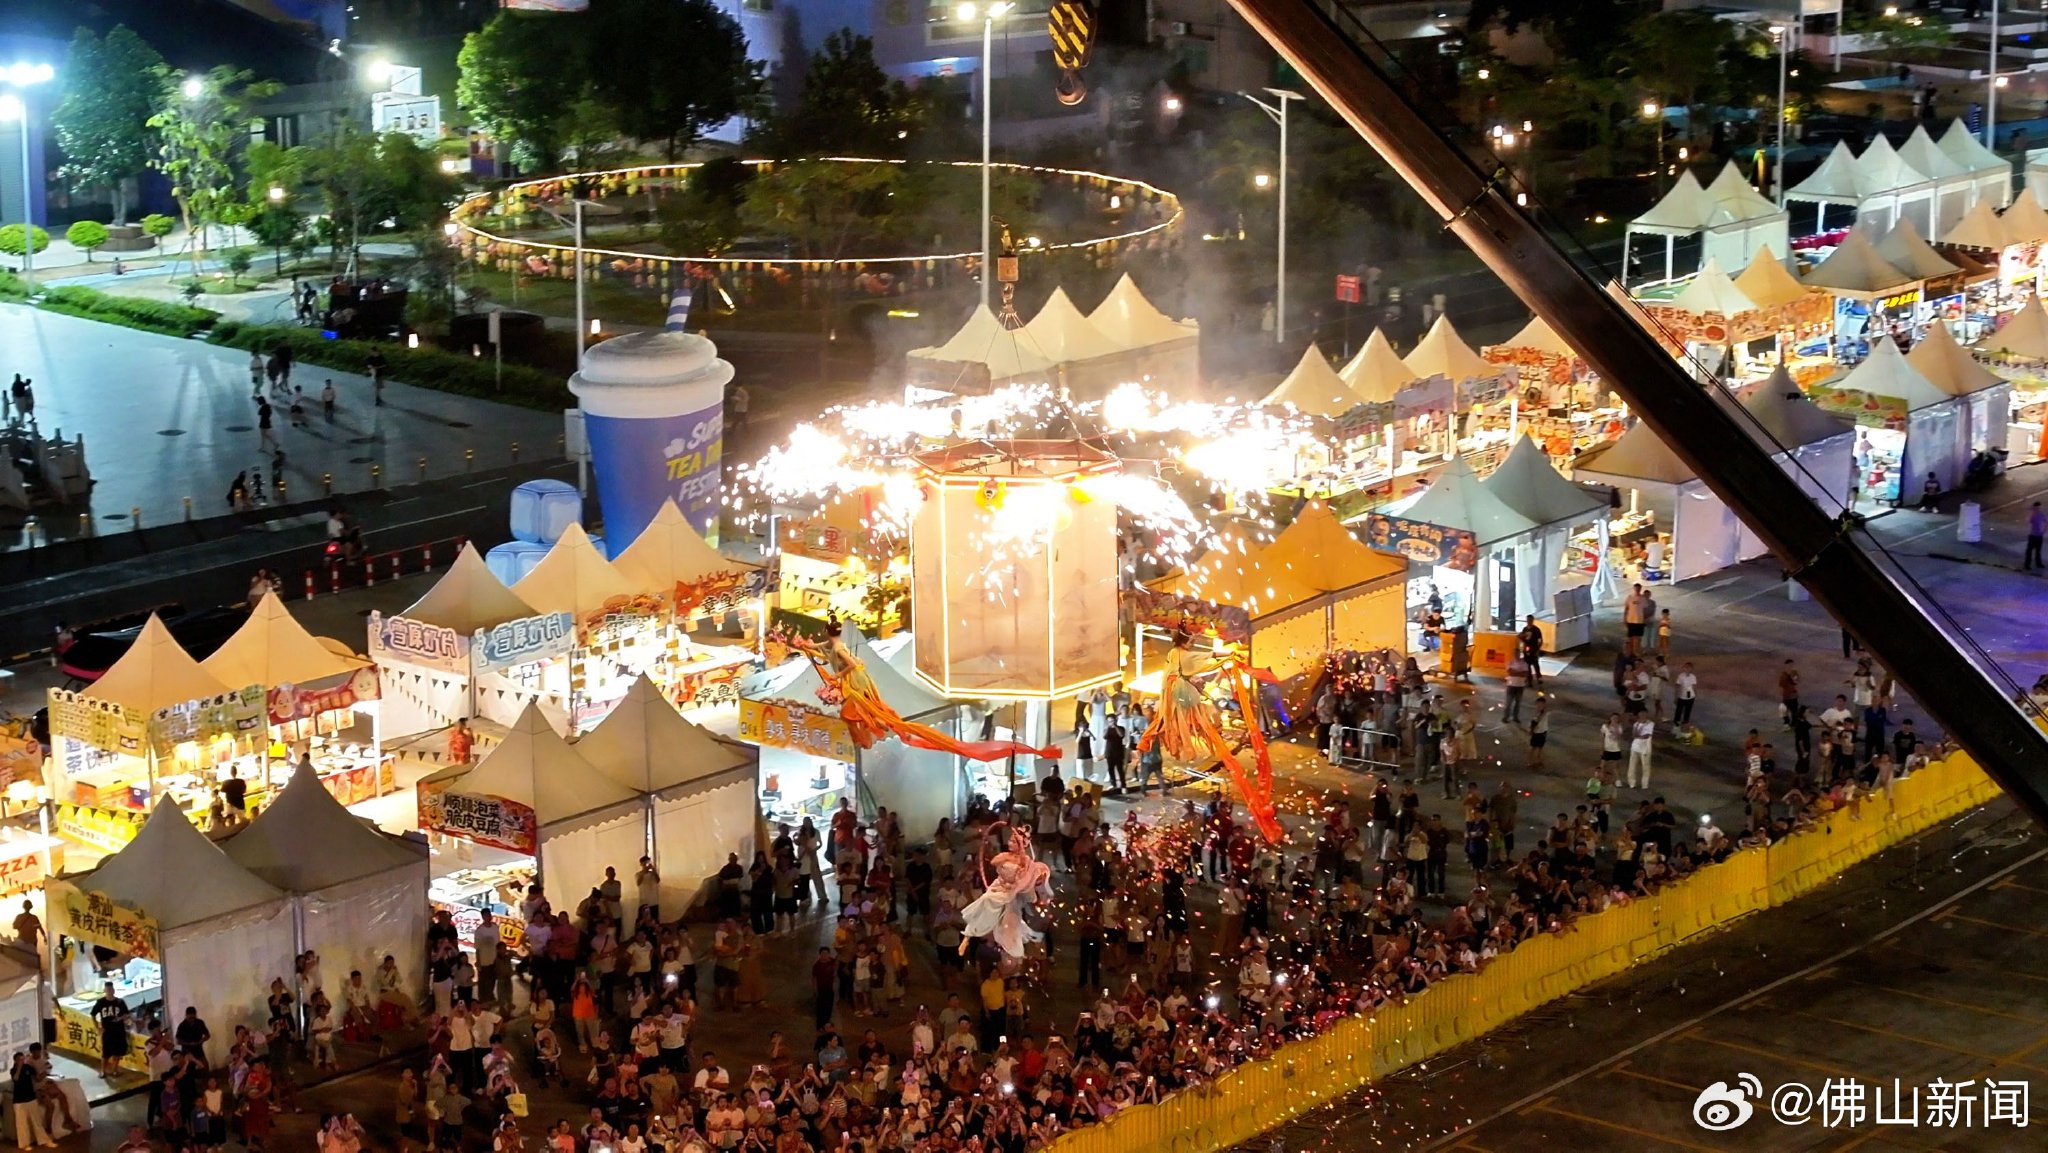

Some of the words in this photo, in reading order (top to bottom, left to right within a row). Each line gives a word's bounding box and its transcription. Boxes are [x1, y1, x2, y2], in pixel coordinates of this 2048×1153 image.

[666, 451, 702, 481] TEA
[444, 808, 502, 838] 脆皮豆腐
[69, 906, 134, 943] 黄皮柠檬茶
[101, 1004, 120, 1019] GAP
